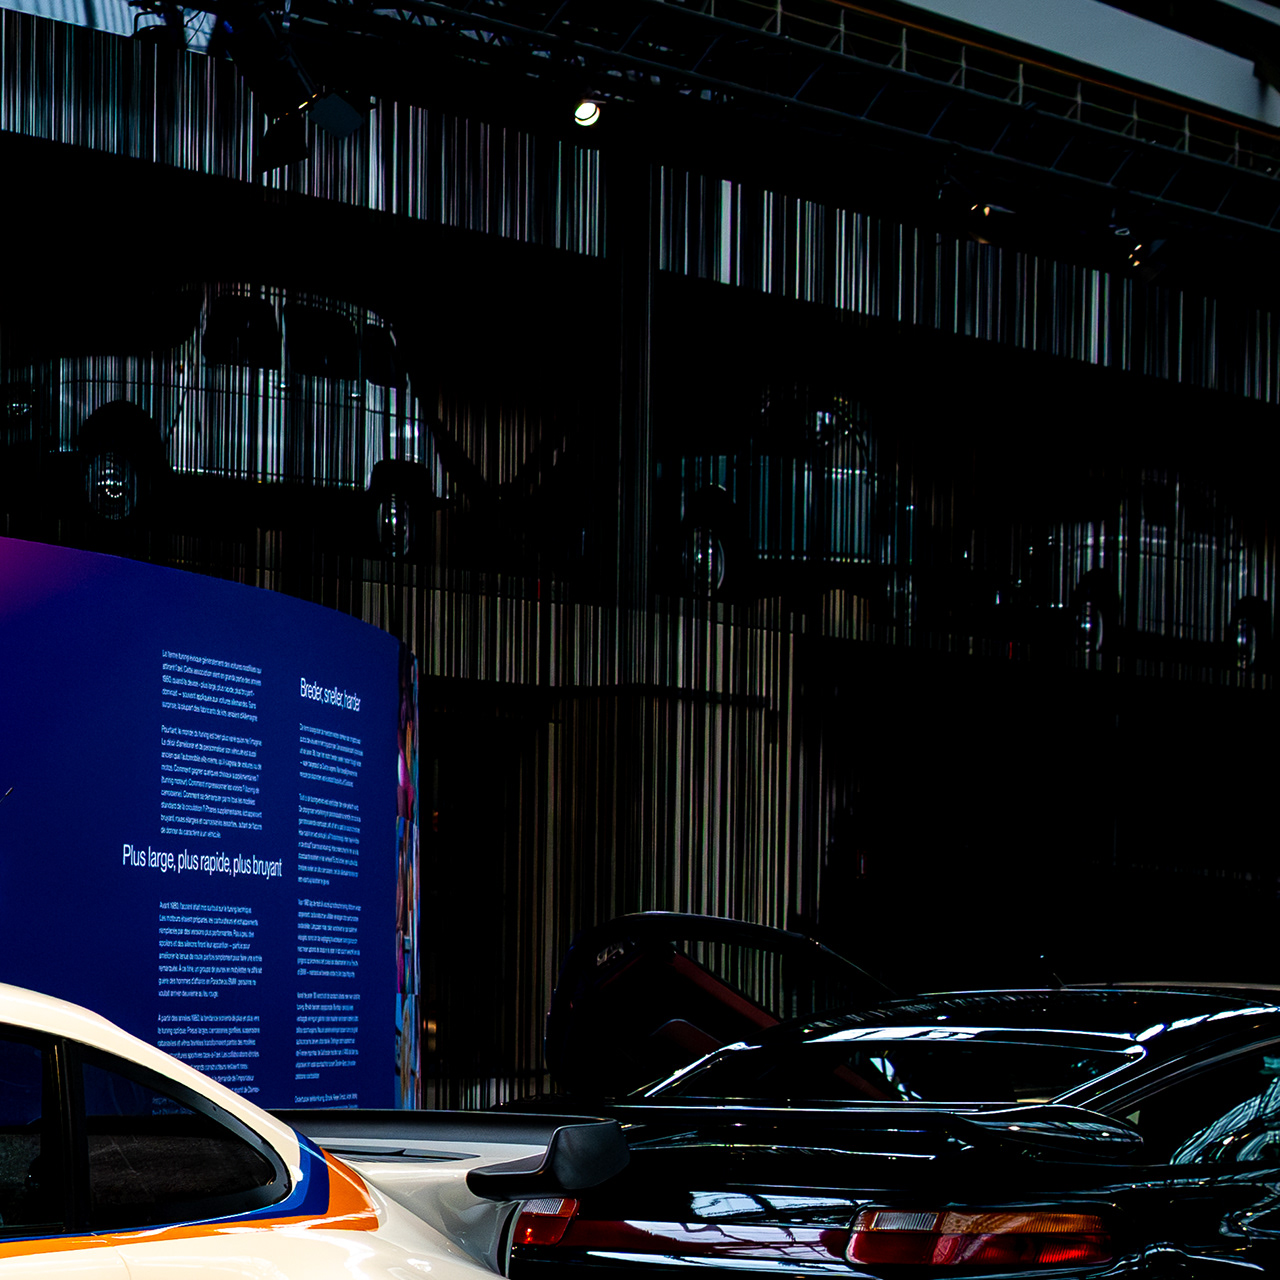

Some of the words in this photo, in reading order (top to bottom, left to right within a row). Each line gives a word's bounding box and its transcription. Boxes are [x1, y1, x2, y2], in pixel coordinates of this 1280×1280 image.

[123, 844, 146, 866] Plus
[148, 846, 176, 872] large,
[178, 849, 198, 873] plus
[201, 852, 231, 875] rapide,
[234, 854, 251, 877] plus
[253, 855, 282, 879] bruyant
